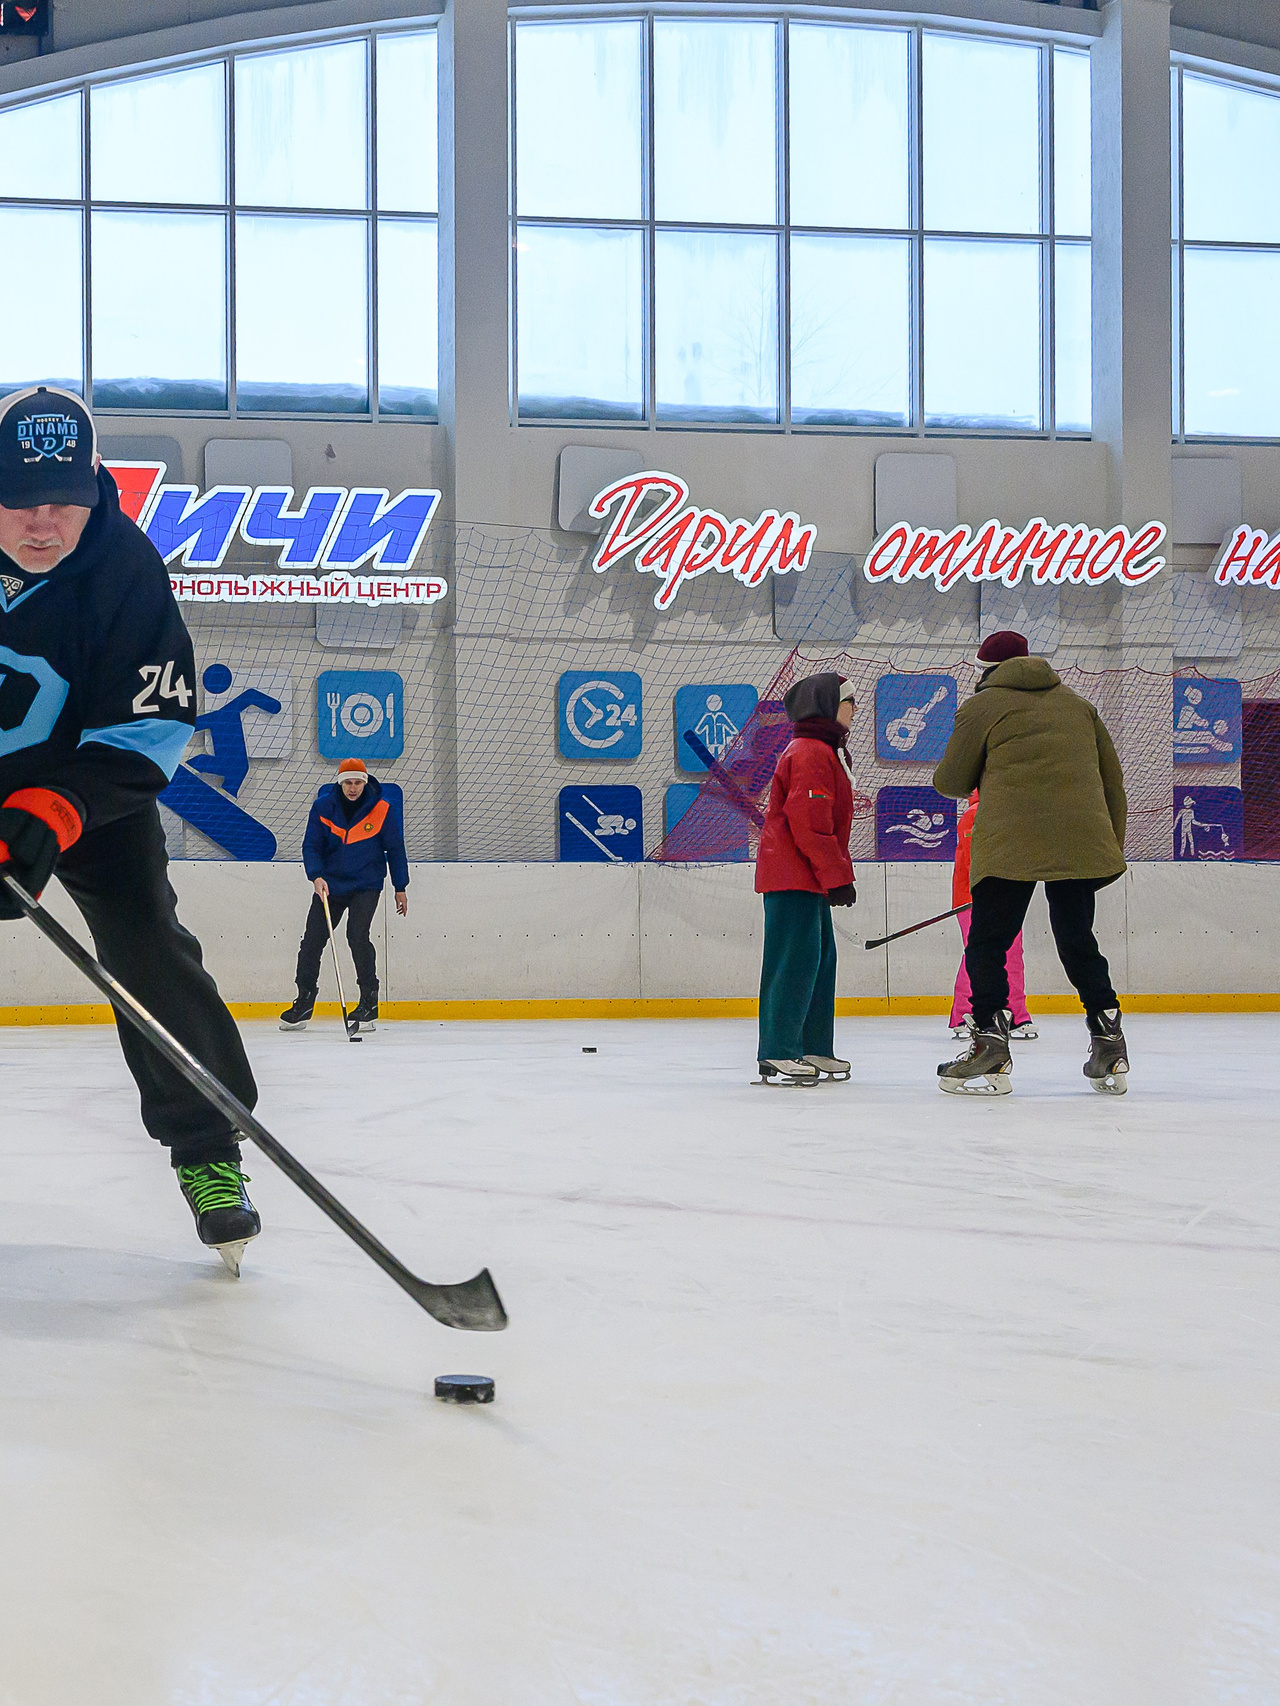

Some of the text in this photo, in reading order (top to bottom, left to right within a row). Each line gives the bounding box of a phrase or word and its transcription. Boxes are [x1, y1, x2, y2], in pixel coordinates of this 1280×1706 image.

[18, 423, 78, 437] DINAMO
[21, 440, 76, 449] 19 48
[594, 476, 812, 605] Дарим
[868, 522, 1161, 587] отличное
[357, 581, 442, 601] ЦЕНТР
[132, 661, 193, 714] 24
[606, 703, 638, 727] 24
